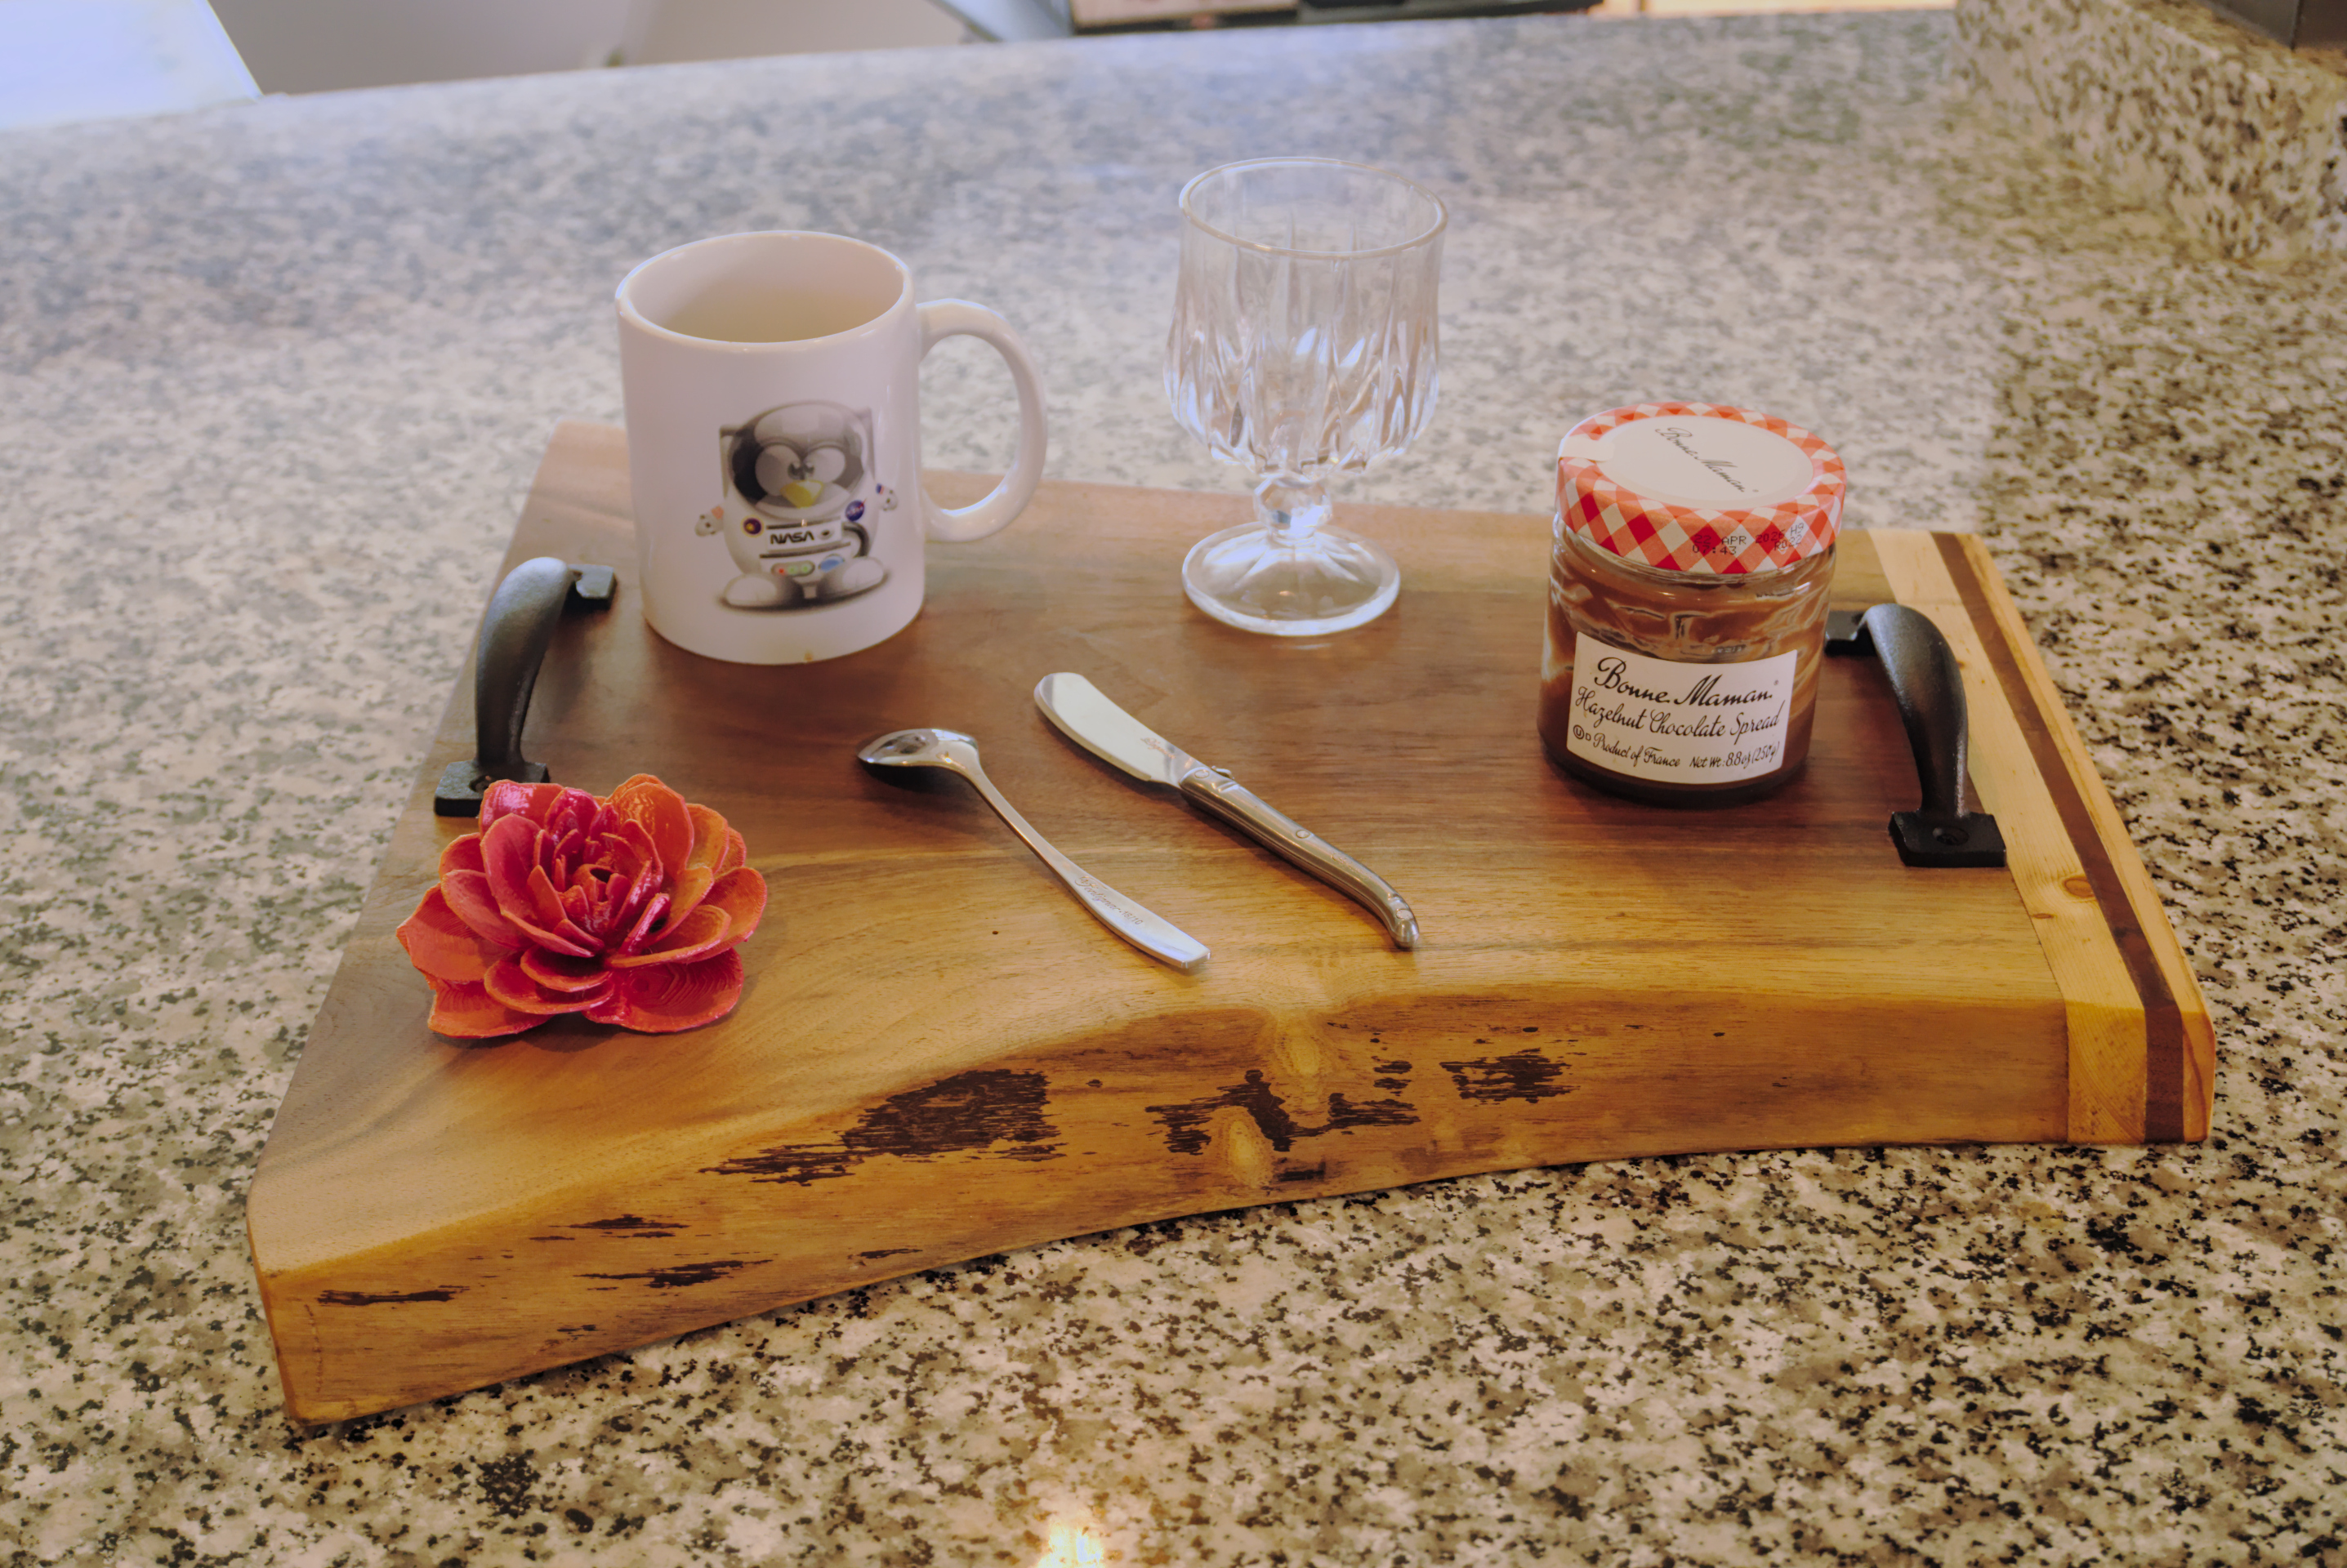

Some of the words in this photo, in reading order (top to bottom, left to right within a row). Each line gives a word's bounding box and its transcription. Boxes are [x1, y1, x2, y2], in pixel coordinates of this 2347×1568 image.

[1654, 427, 1698, 457] Bonne
[1693, 457, 1746, 492] Maman
[770, 530, 815, 545] NASA
[1692, 544, 1737, 555] 07:43
[1693, 534, 1712, 546] 22
[1721, 535, 1747, 546] APR
[1594, 656, 1671, 704] Bonne
[1673, 673, 1773, 707] Maman
[1574, 685, 1645, 728] Hazelnut
[1649, 708, 1726, 737] Chocolate
[1729, 699, 1786, 746] Spread
[1593, 733, 1632, 759] Product
[1630, 744, 1644, 768] of
[1644, 746, 1681, 768] France
[1689, 755, 1708, 768] Net
